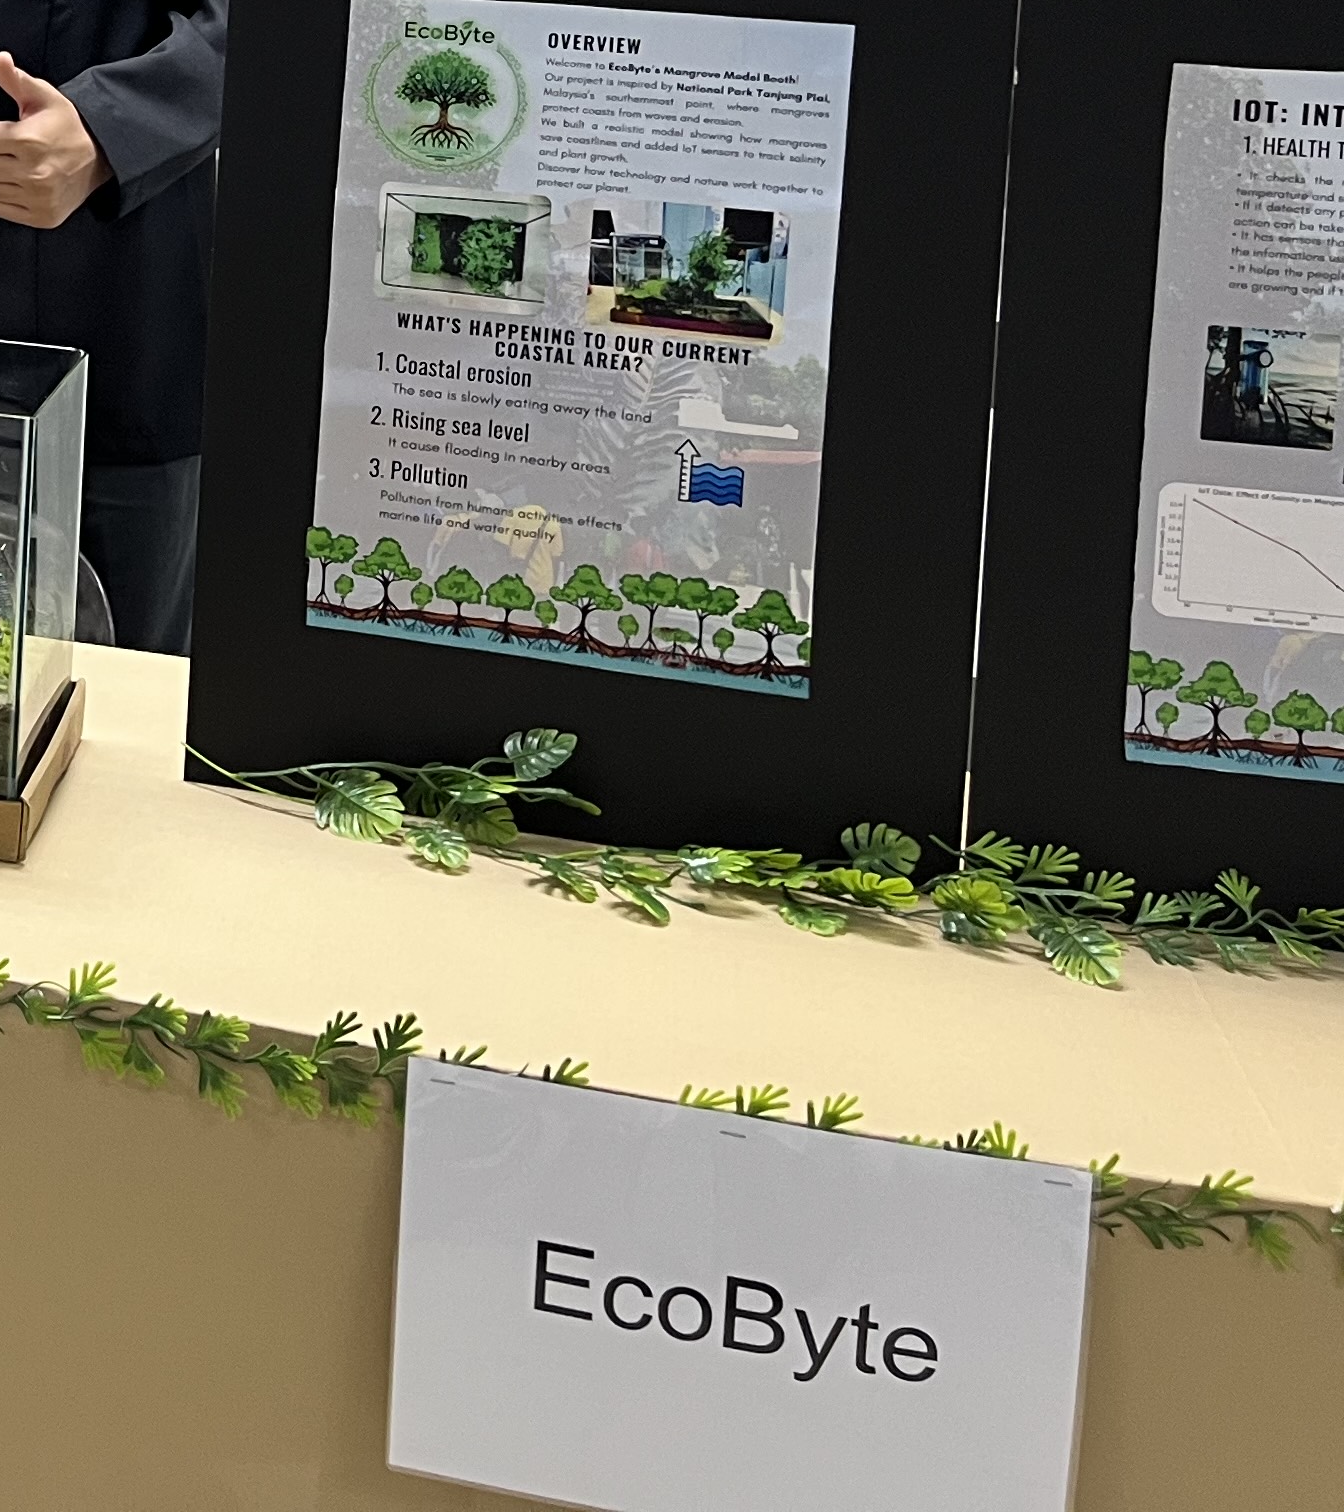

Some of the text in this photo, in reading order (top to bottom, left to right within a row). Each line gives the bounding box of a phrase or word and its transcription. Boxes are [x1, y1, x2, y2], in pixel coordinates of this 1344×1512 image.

[404, 21, 495, 46] EcoByte
[547, 32, 641, 55] OVERVIEW
[545, 57, 592, 70] Welcome
[596, 61, 606, 71] to
[608, 59, 661, 77] EcoByte's
[663, 66, 721, 79] Mangrove
[723, 71, 761, 82] Model
[544, 72, 564, 82] Our
[566, 75, 604, 88] project
[606, 76, 614, 86] is
[617, 78, 658, 91] inspired
[661, 81, 673, 92] by
[676, 82, 724, 95] National
[727, 86, 753, 97] Park
[756, 88, 803, 103] Tanjung
[542, 103, 580, 115] protect
[582, 107, 615, 118] coasts
[618, 106, 642, 119] from
[645, 112, 677, 123] waves
[679, 114, 701, 124] and
[1232, 98, 1288, 124] IOT:
[1243, 135, 1331, 160] 1. HEALTH
[537, 161, 824, 197] Discover how technology and nature work together to
[1233, 217, 1271, 228] action
[1273, 220, 1296, 231] can
[1299, 221, 1315, 232] be
[397, 311, 753, 366] WHAT'S HAPPENING TO OUR CURRENT
[376, 351, 533, 388] 1. Coastal erosion
[495, 341, 644, 373] COASTAL AREA?
[392, 381, 652, 424] The sea is slowly eating away the land
[370, 405, 530, 443] 2. Rising sea level
[388, 436, 611, 475] It cause flooding in nearby areas
[368, 457, 468, 489] 3. Pollution
[379, 509, 556, 543] marine life and water quality
[380, 489, 623, 532] Pollution from humans activities effects
[532, 1238, 940, 1383] EcoByte
